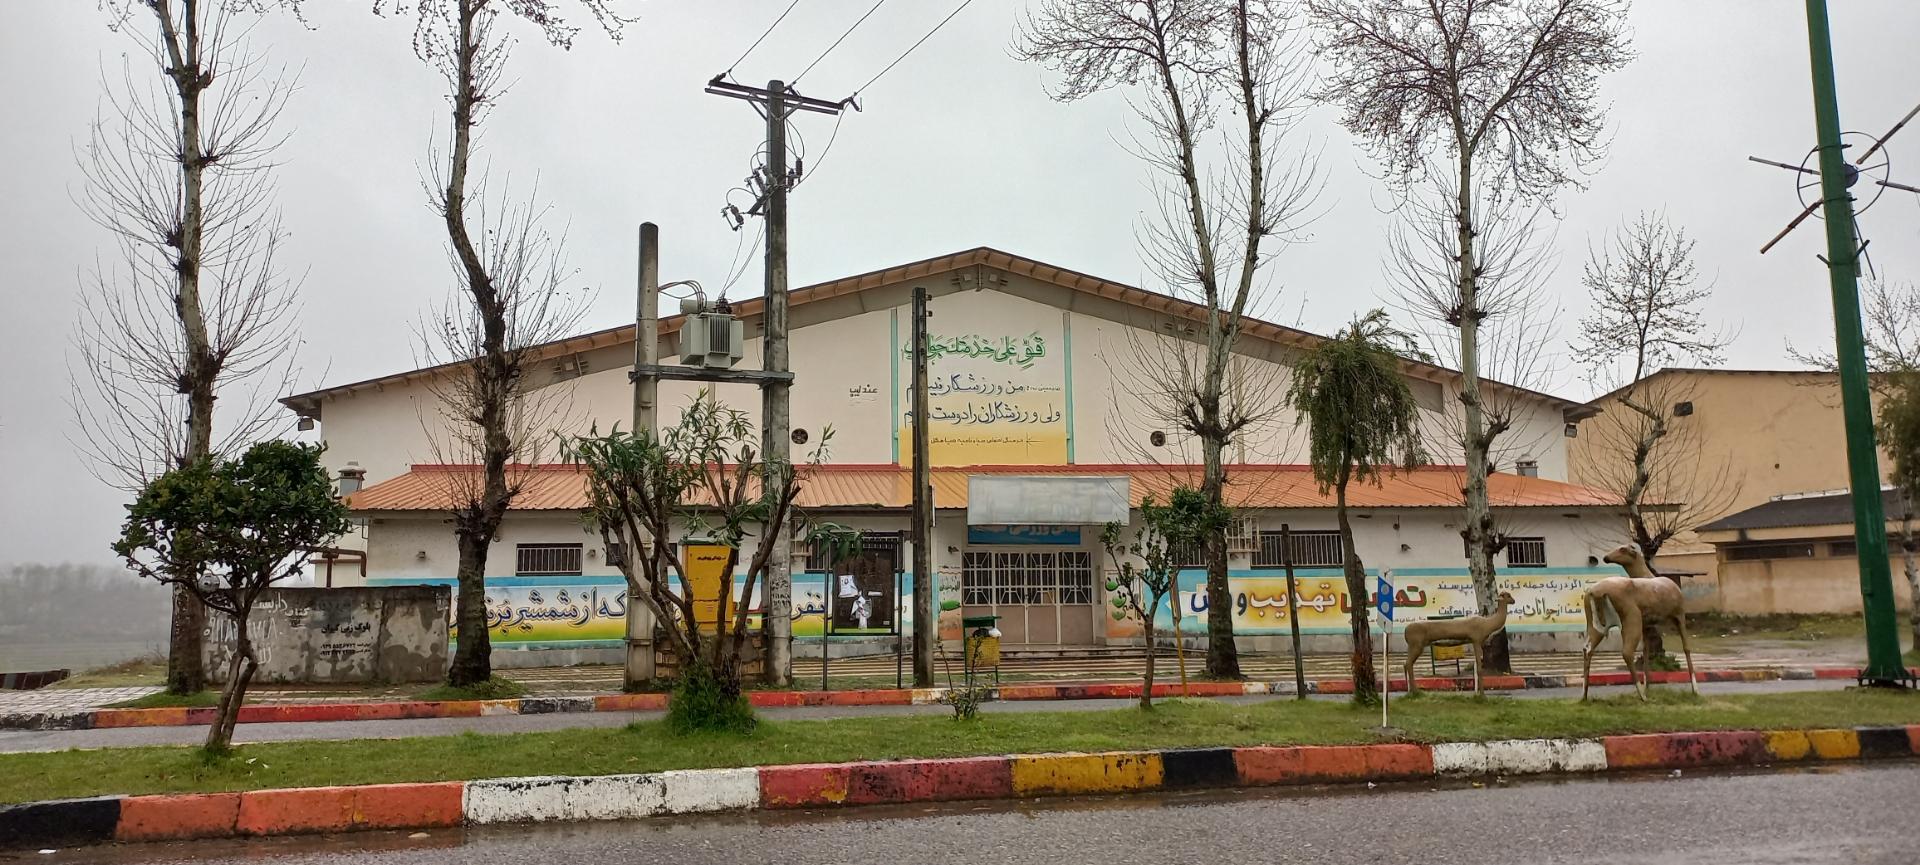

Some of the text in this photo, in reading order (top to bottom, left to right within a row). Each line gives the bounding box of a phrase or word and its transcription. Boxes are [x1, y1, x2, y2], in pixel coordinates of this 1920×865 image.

[932, 406, 968, 424] دوست
[1040, 403, 1061, 423] ولی
[1523, 581, 1545, 592] جمله
[506, 589, 578, 632] شمشیر
[568, 586, 597, 627] از
